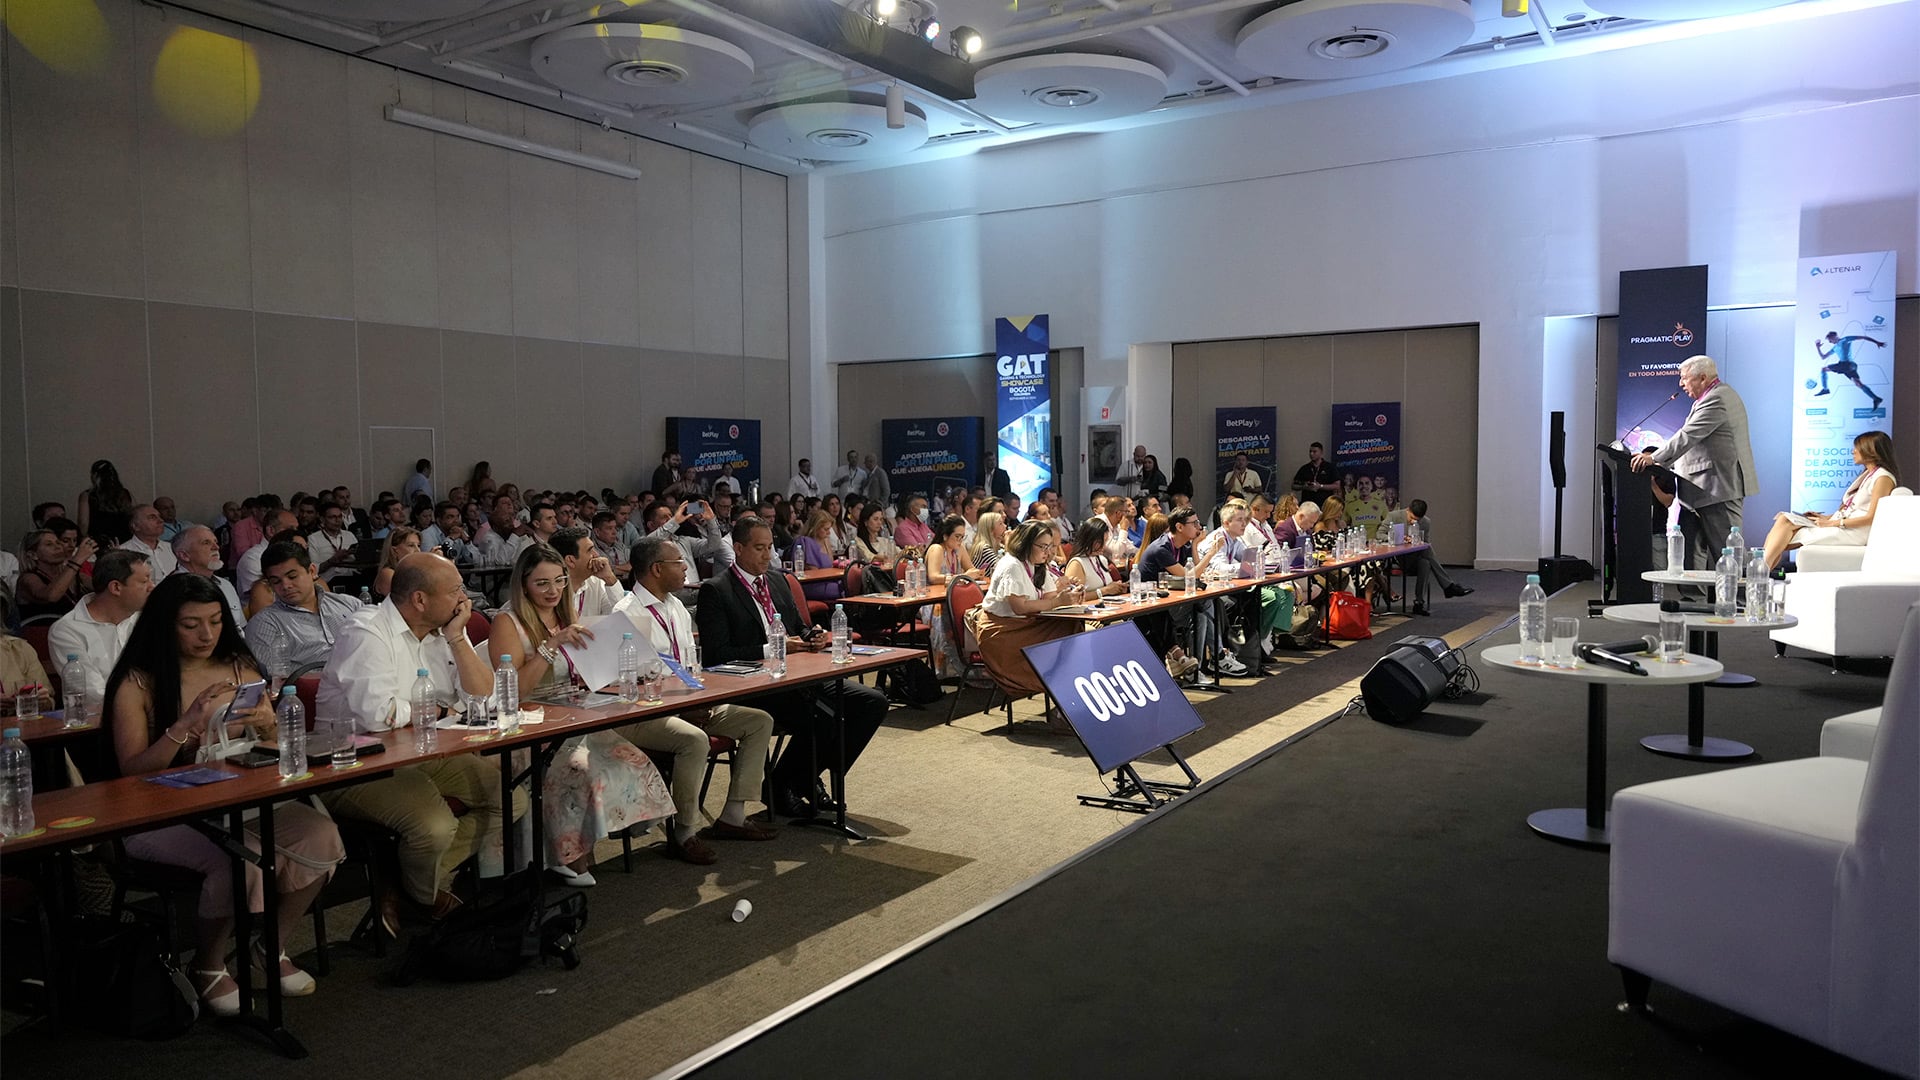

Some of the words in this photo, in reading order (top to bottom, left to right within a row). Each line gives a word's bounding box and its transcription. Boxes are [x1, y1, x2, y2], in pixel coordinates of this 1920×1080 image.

[1630, 335, 1673, 344] PRAGMATIC
[996, 353, 1047, 377] GAT
[1001, 379, 1044, 387] SHOWCASE
[1226, 419, 1253, 428] BetPlay
[1218, 435, 1259, 444] DESCARGA
[1344, 438, 1382, 446] APOSTAMOS
[1219, 443, 1233, 452] LA
[1236, 440, 1260, 450] APP
[1261, 440, 1269, 448] Y
[699, 450, 737, 459] APOSTAMOS
[901, 450, 949, 460] APOSTAMOS
[1806, 448, 1821, 456] TU
[694, 458, 713, 467] POR
[895, 459, 917, 467] POR
[919, 457, 933, 465] UN
[1804, 459, 1819, 467] DE
[1822, 458, 1860, 467] APUE
[908, 465, 932, 473] JUEGA
[932, 461, 965, 472] UNIDO
[1804, 470, 1862, 478] DEPORTIV
[1804, 481, 1836, 489] PARA
[1074, 660, 1160, 722] 00:00
